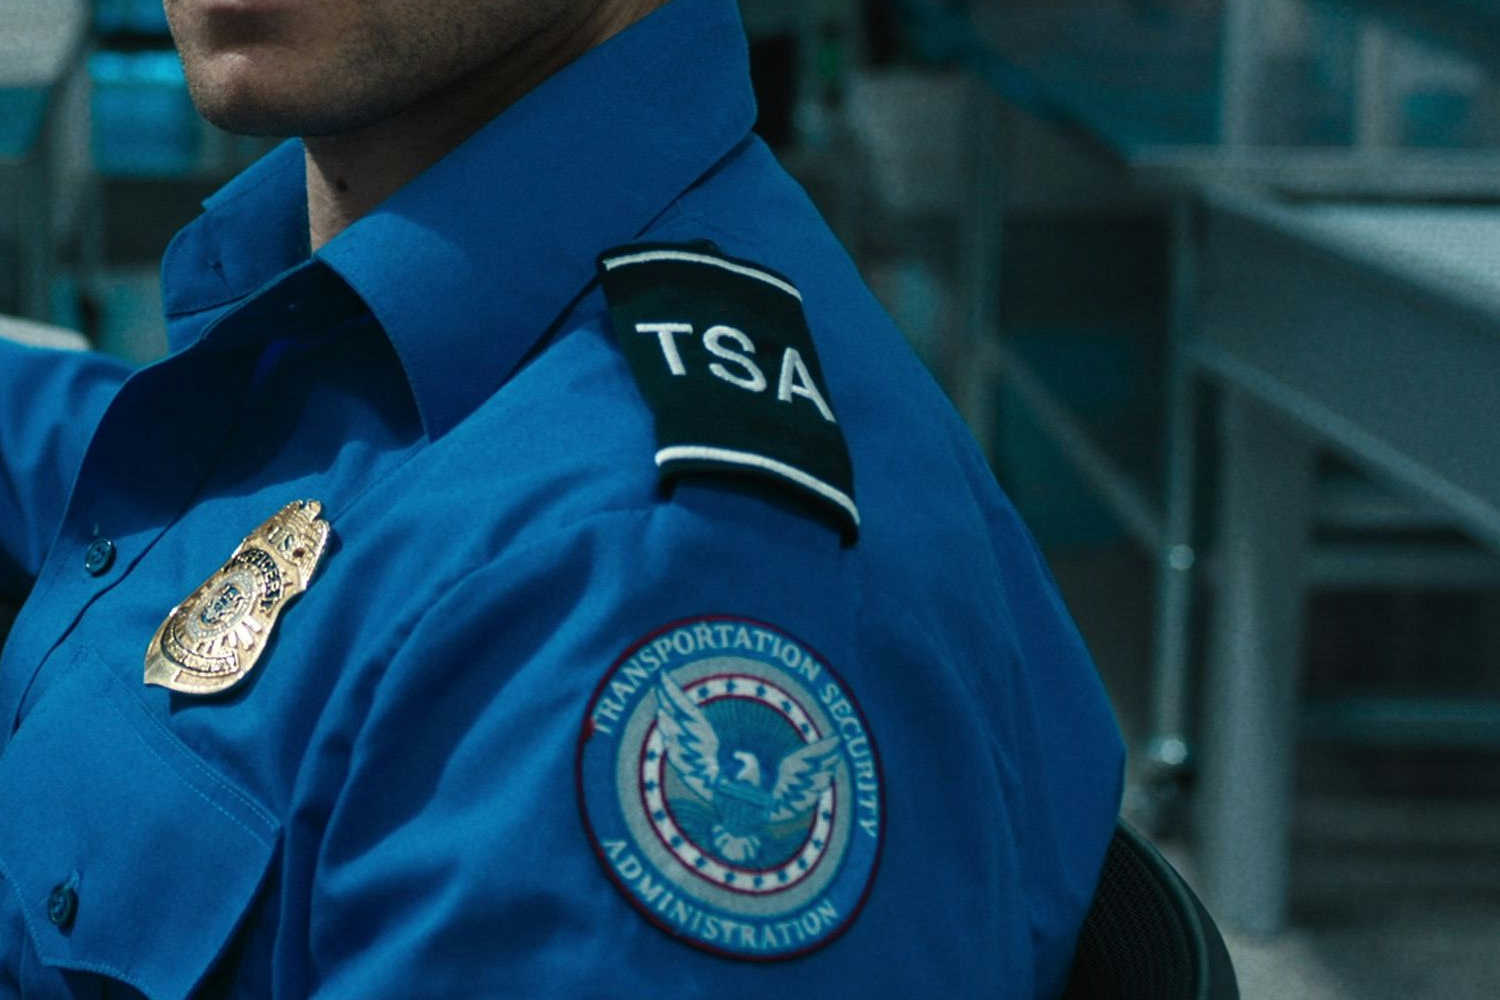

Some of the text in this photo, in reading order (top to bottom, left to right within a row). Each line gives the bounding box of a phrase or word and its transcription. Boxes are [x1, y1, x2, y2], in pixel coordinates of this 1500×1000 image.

[634, 322, 837, 424] TSA
[592, 620, 879, 838] TRANSPORTATION SECURITY
[602, 837, 838, 950] ADMINISTRATION
